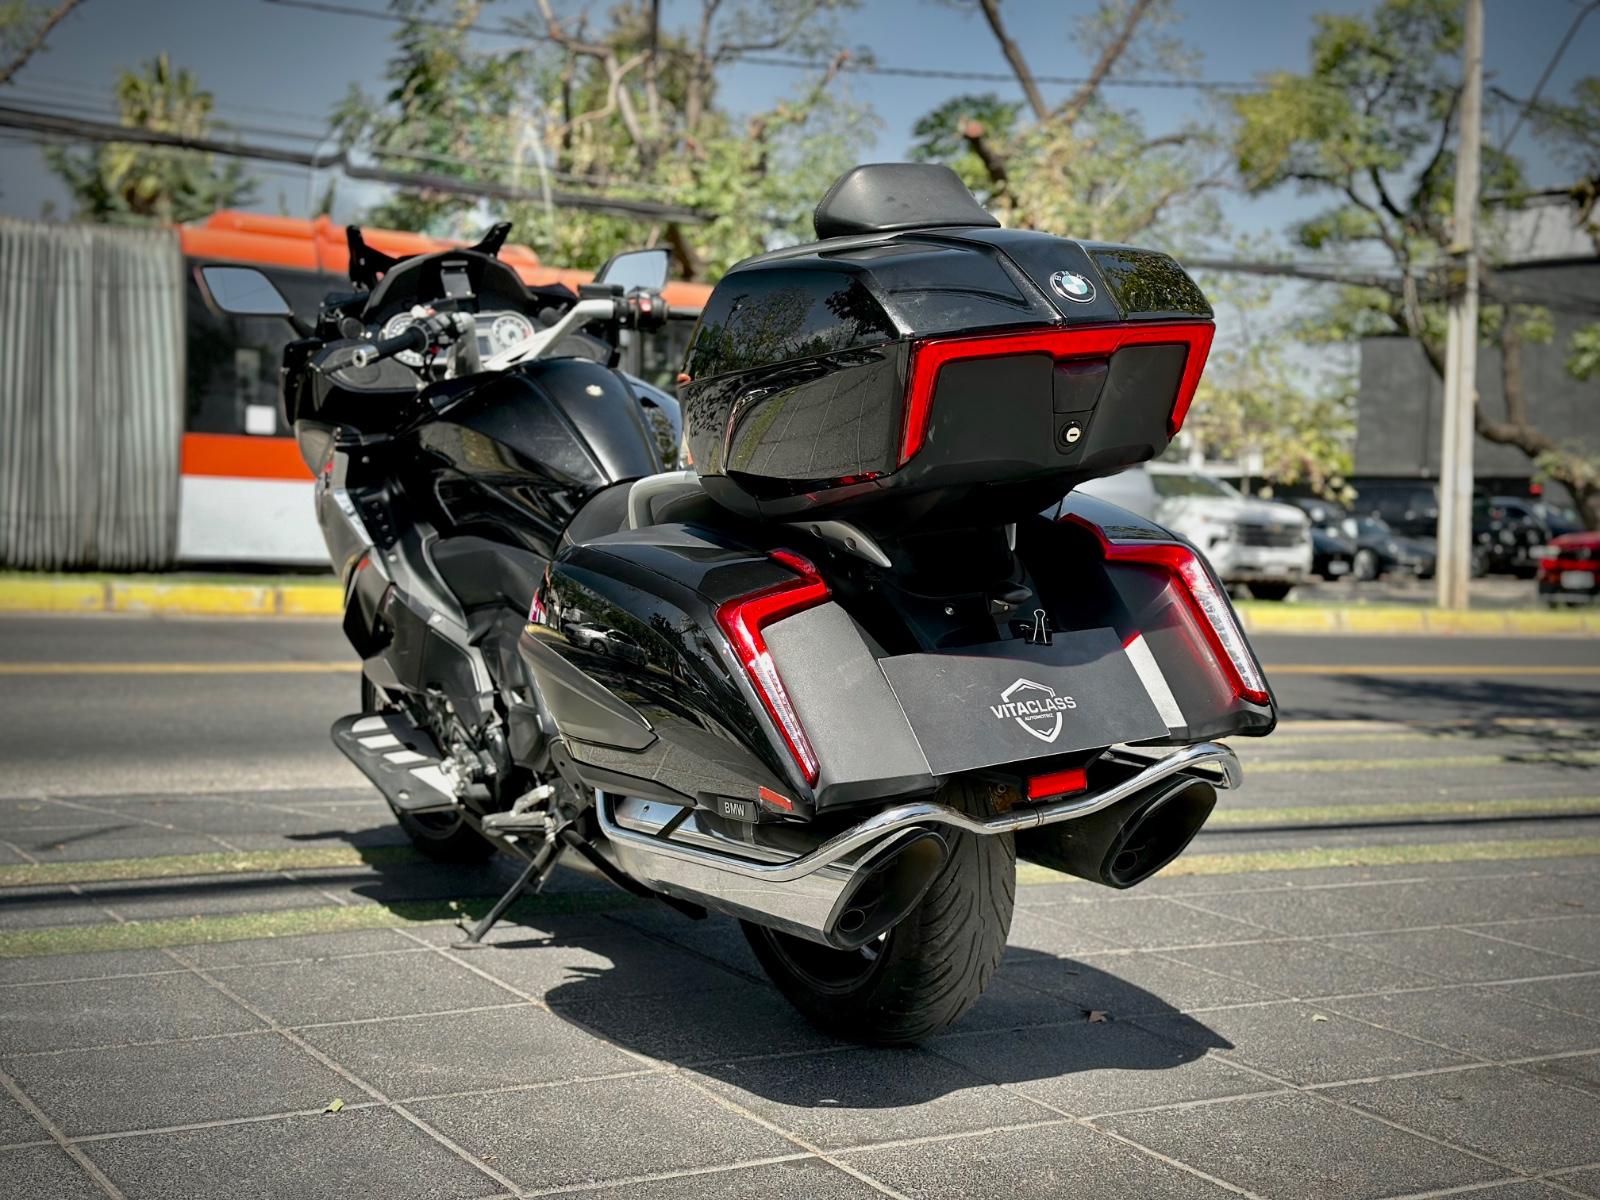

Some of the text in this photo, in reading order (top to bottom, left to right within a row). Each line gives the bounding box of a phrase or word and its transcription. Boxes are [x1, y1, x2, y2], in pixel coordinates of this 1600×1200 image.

[1054, 271, 1083, 281] BMW
[990, 696, 1077, 719] VITACLASS
[724, 801, 745, 817] BMW
